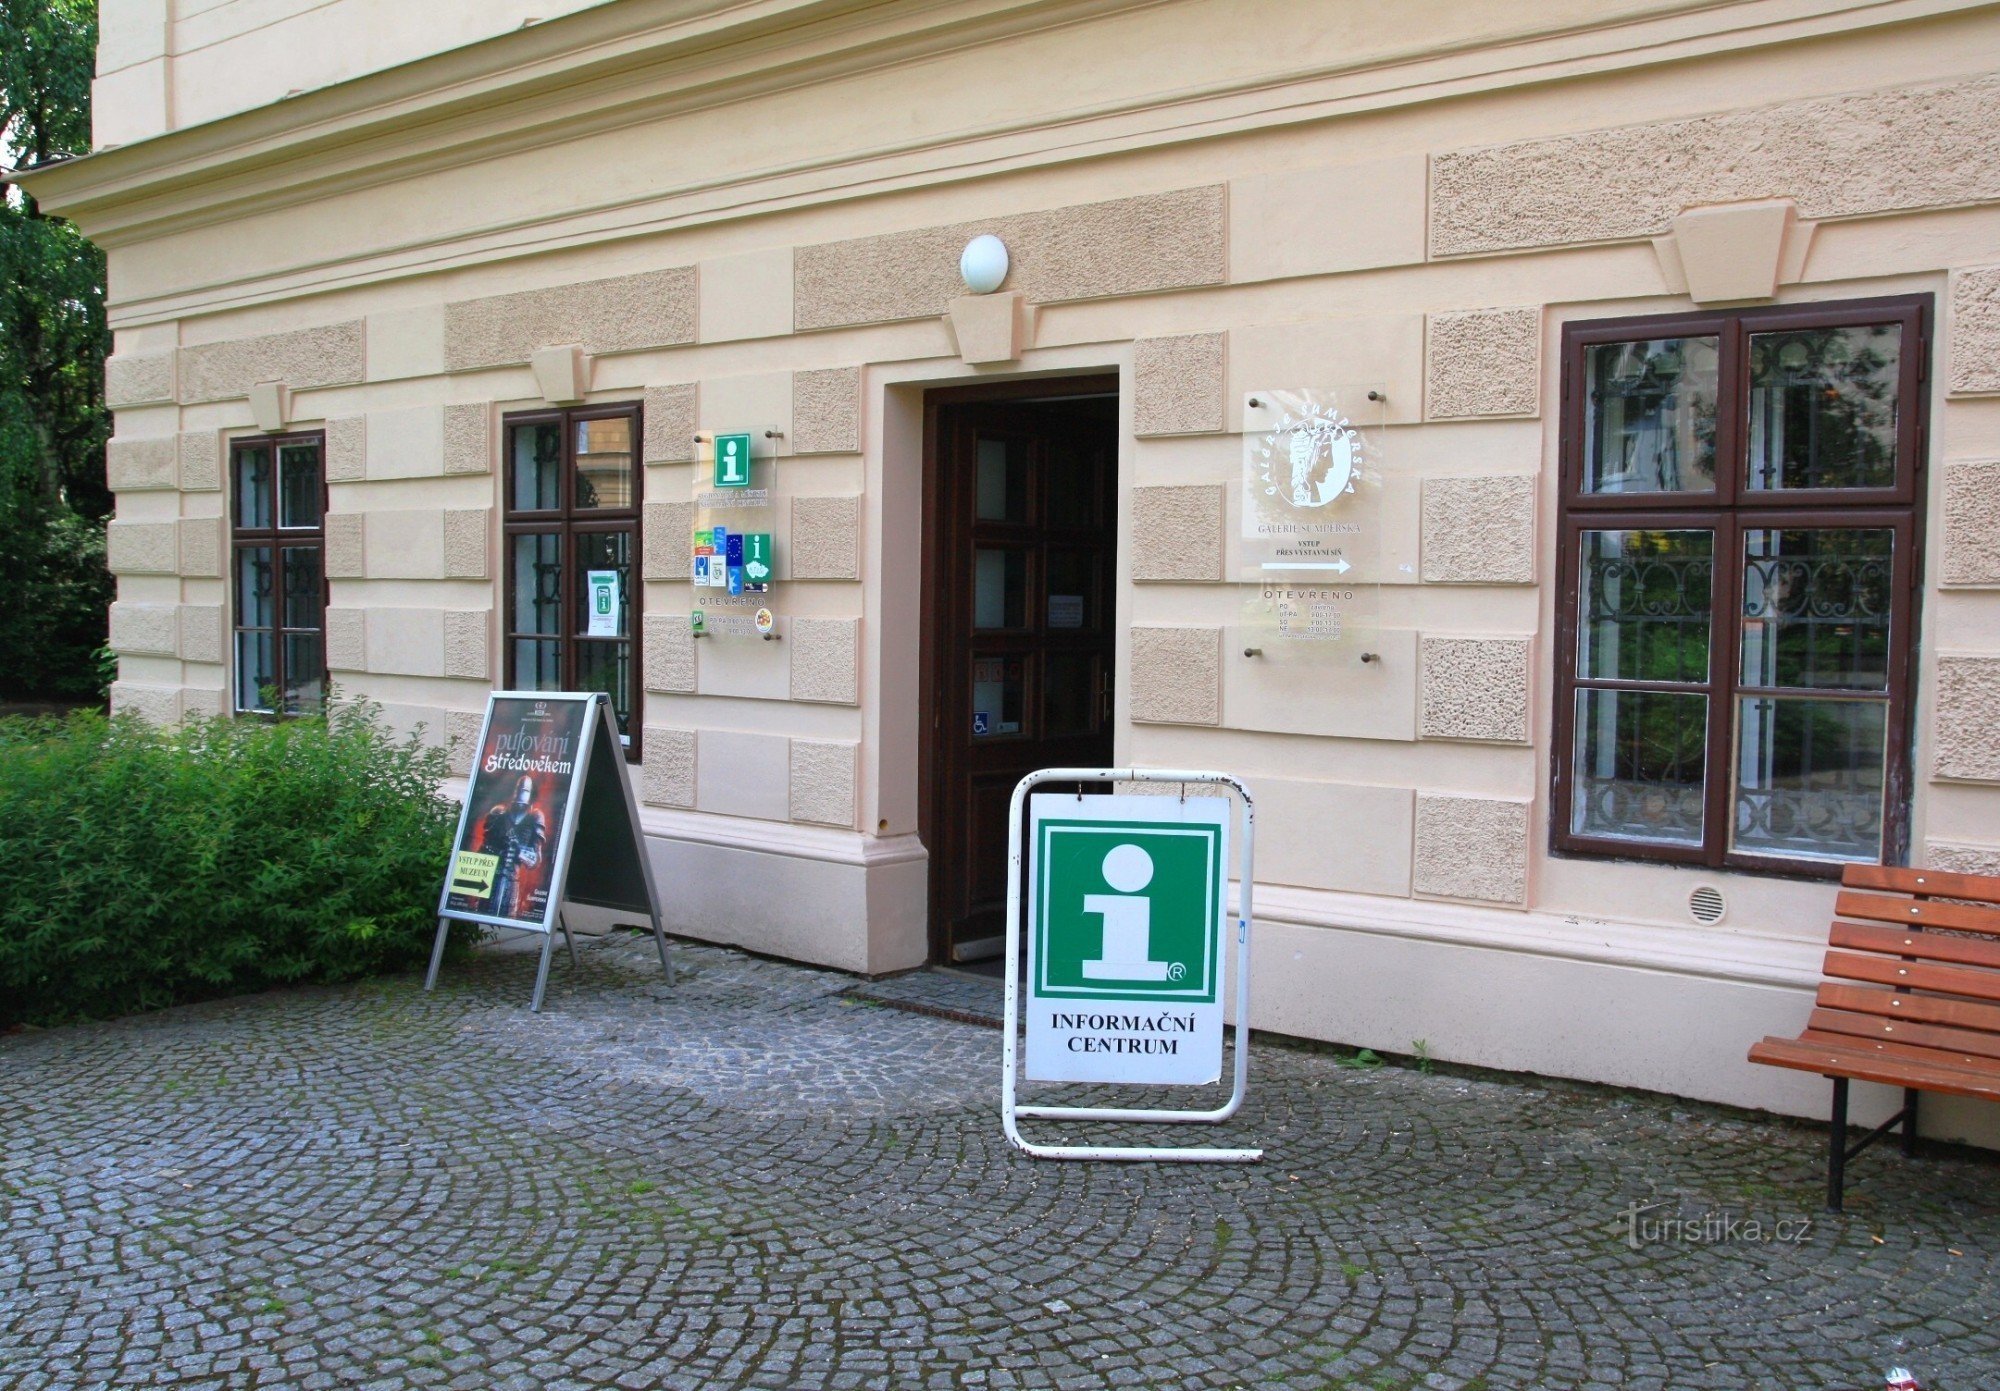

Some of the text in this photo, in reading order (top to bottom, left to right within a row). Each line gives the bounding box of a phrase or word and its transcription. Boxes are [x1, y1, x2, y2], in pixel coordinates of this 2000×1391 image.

[1298, 540, 1320, 548] VSTUP
[1276, 547, 1293, 556] PŘES
[485, 753, 571, 774] Středověkem
[459, 856, 477, 865] VSTUP
[1051, 1011, 1196, 1033] INFORMAČNÍ
[1067, 1036, 1178, 1054] CENTRUM
